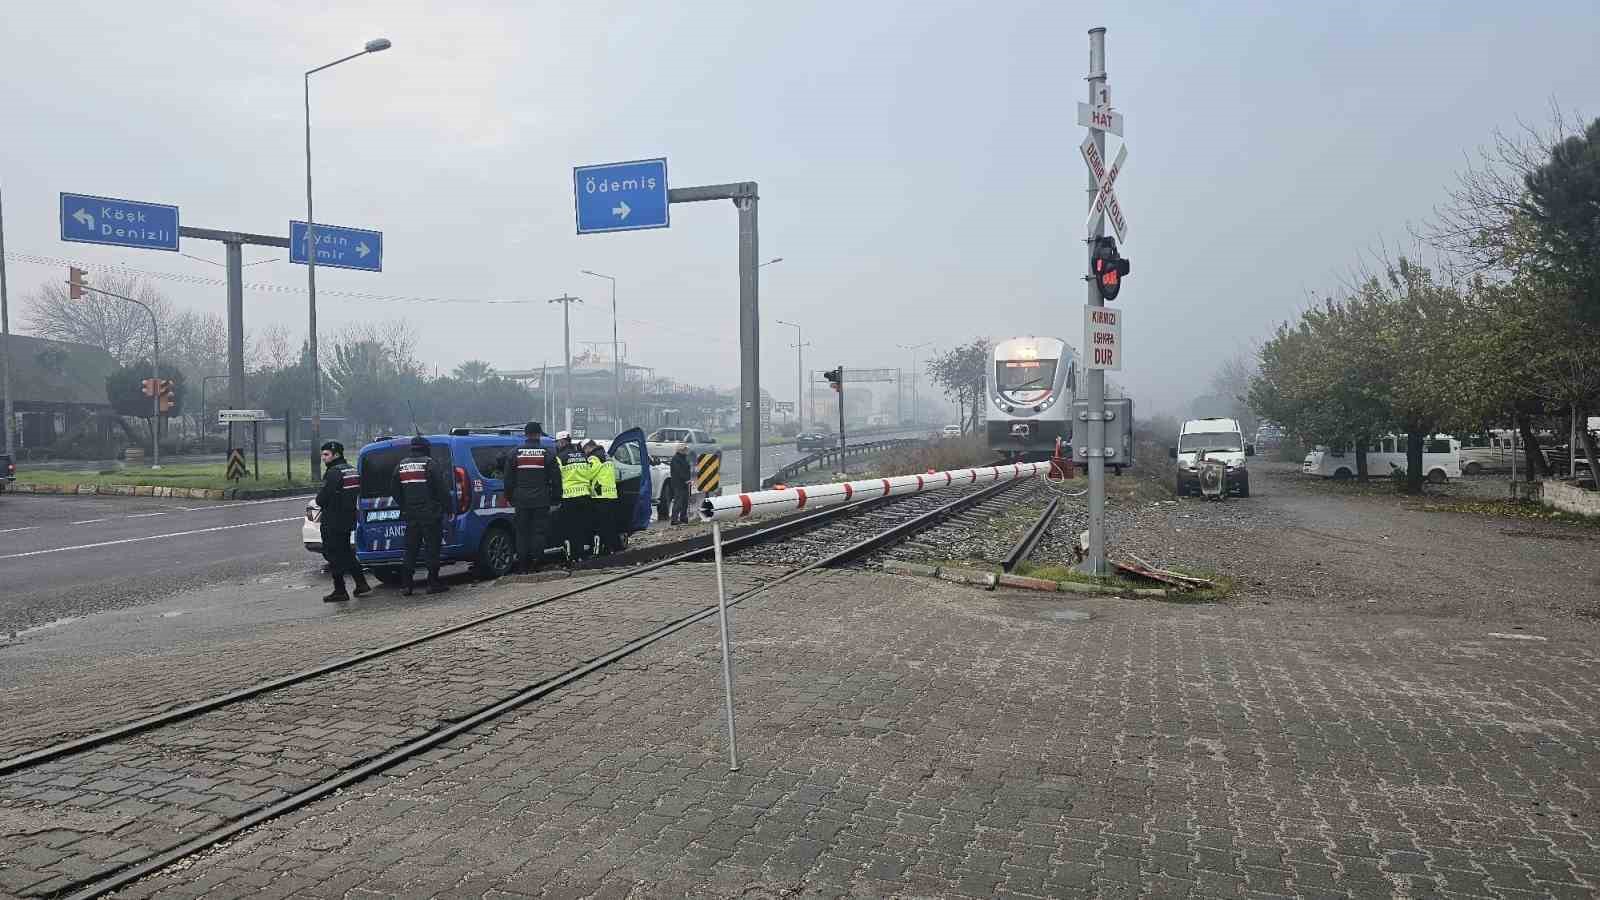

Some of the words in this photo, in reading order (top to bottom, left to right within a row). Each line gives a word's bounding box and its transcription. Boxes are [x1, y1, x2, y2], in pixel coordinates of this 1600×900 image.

[1099, 89, 1107, 103] 1
[1092, 111, 1112, 128] HAT
[585, 176, 657, 194] Ödemiş
[101, 207, 146, 224] Köşk
[101, 224, 169, 242] Denizli
[1094, 348, 1113, 366] DUR
